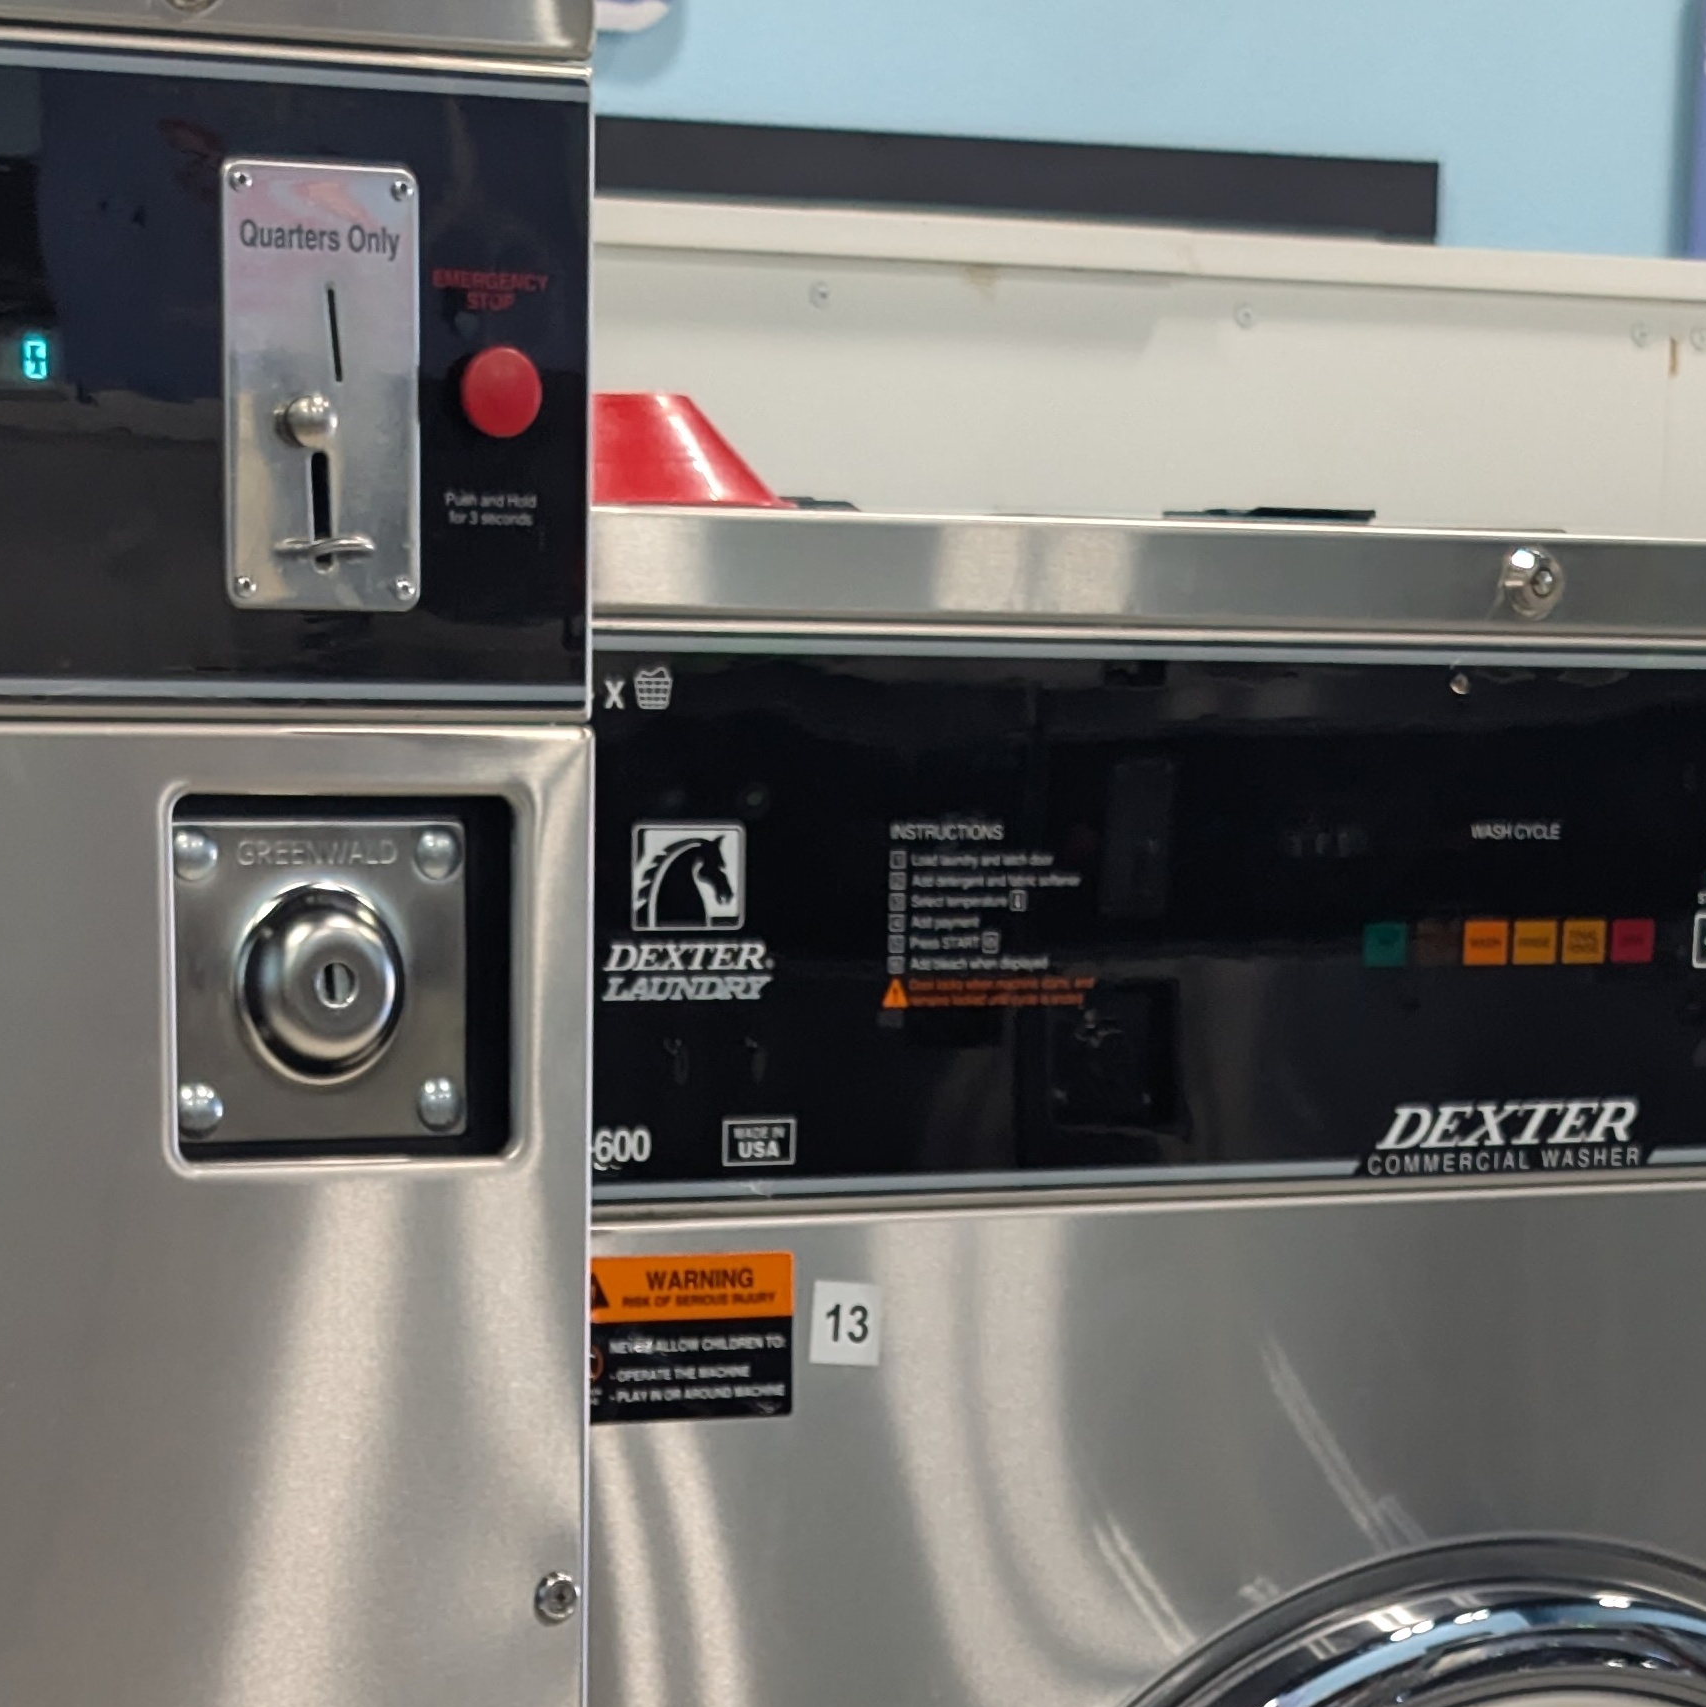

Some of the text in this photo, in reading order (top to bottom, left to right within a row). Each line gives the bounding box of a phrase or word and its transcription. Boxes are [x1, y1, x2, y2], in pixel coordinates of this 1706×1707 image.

[239, 219, 400, 261] Quarters Only
[432, 269, 548, 291] EMERGENCY
[466, 292, 516, 311] STOP
[445, 491, 537, 509] Push and Hold
[448, 510, 533, 527] for 3 seconds
[889, 824, 1004, 840] INSTRUCTIONS
[1470, 823, 1562, 840] WASH CYCLE
[236, 839, 398, 867] GREENWALD
[603, 942, 765, 971] DEXTER
[602, 976, 773, 1001] LAUNDRY
[733, 1125, 786, 1140] MADE IN
[1375, 1099, 1639, 1150] DEXTER
[592, 1126, 652, 1164] 600
[737, 1141, 781, 1158] USA
[1367, 1147, 1640, 1176] COMMERCIAL WASHER
[646, 1268, 754, 1291] WARNING
[622, 1294, 651, 1308] RISK
[654, 1293, 671, 1307] OF
[826, 1304, 869, 1343] 13
[654, 1338, 699, 1353] ALLOW
[701, 1335, 764, 1351] CHILDREN
[616, 1365, 751, 1382] OPERATE THE MACHINE
[615, 1389, 647, 1402] PLAY
[684, 1386, 733, 1399] AROUND
[734, 1383, 786, 1397] MACHINE
